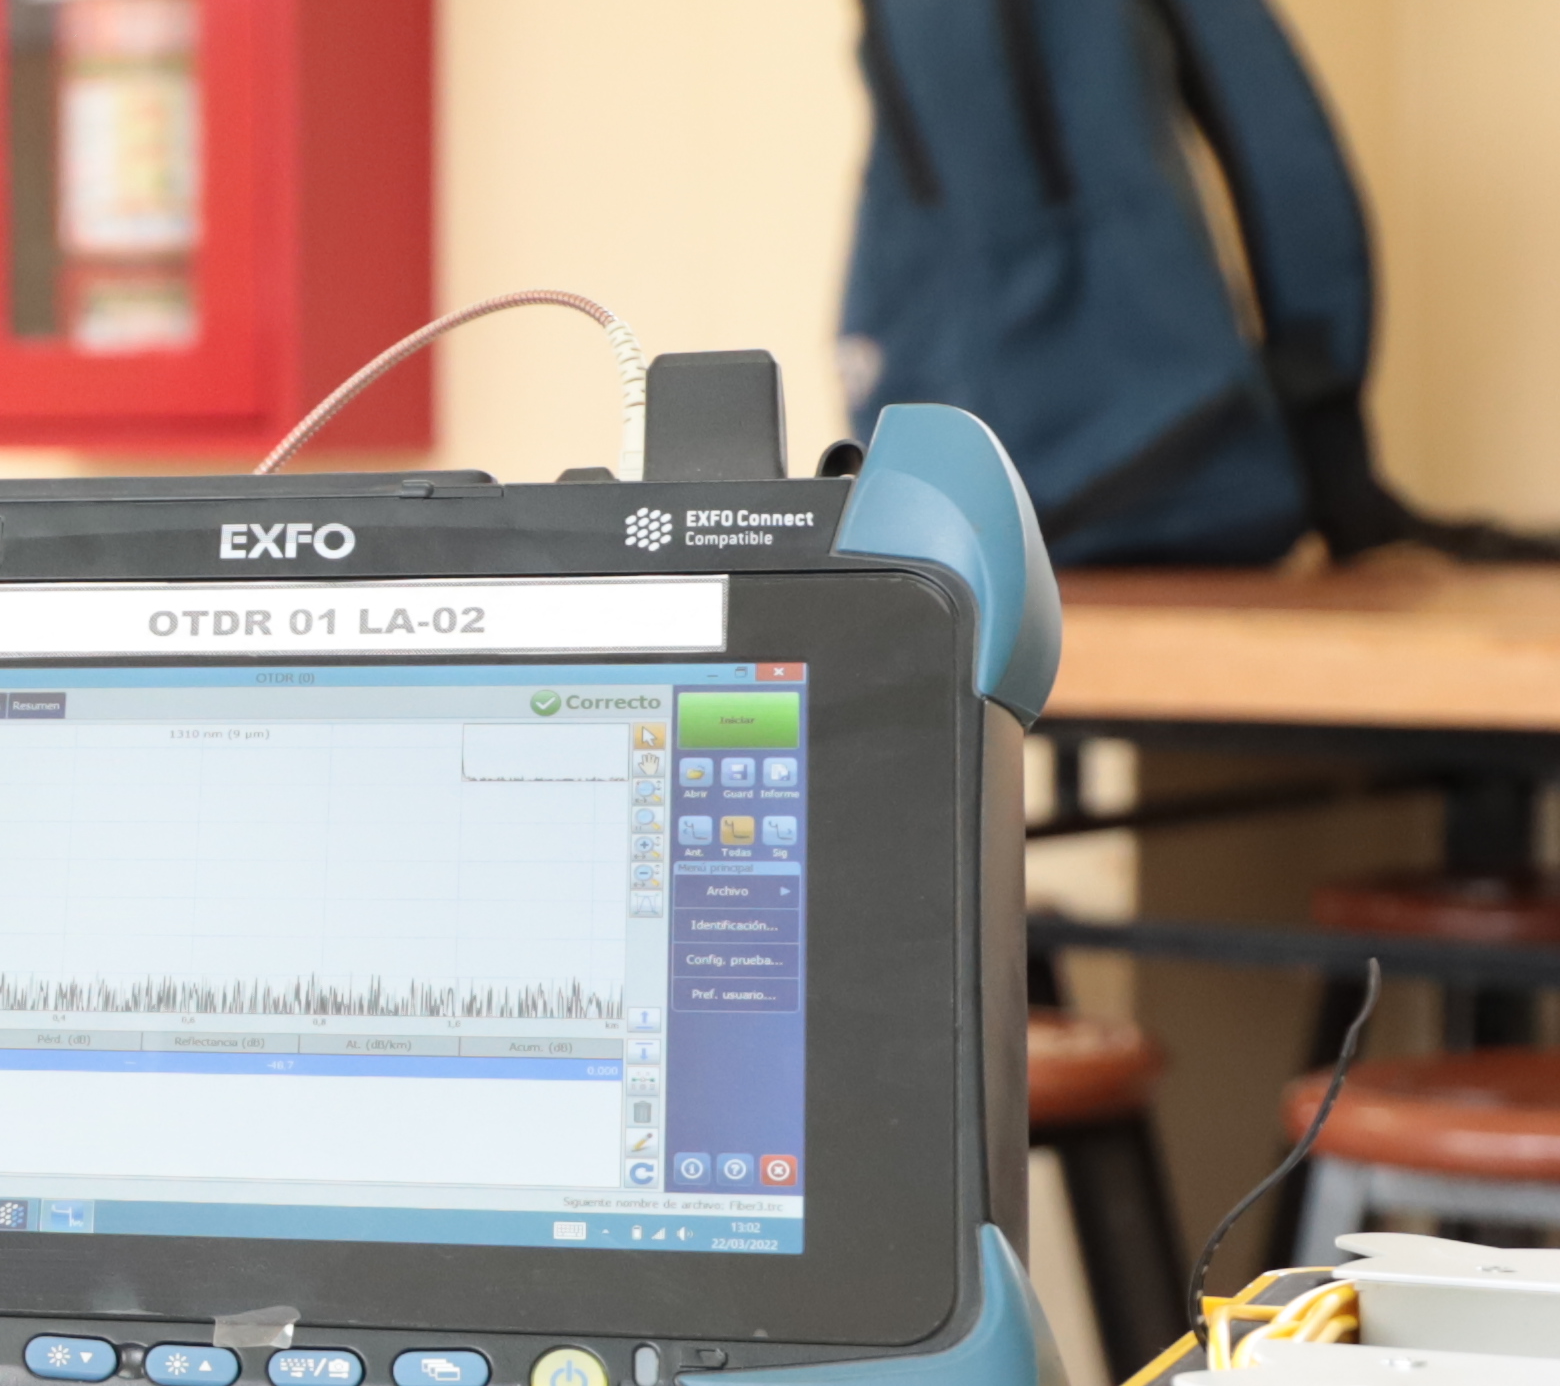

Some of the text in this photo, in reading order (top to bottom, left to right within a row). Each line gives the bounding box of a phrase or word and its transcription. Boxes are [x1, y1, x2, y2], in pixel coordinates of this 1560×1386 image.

[685, 510, 814, 527] EXFO Connect
[220, 522, 356, 559] EXFO
[685, 529, 773, 548] Compatible
[147, 606, 486, 637] OTDR 01 LA-02
[255, 671, 315, 685] OTDR (0)
[12, 700, 60, 711] Resumen
[565, 694, 661, 710] Correcto
[719, 715, 756, 725] Iniciar
[169, 729, 200, 739] 1310
[684, 789, 708, 799] Abrir
[723, 789, 754, 799] Guard
[760, 789, 800, 799] Informe
[721, 848, 752, 857] Todas
[710, 864, 754, 875] principal
[706, 885, 749, 897] Archivo
[686, 953, 726, 967] Config.
[691, 988, 718, 1000] Pref.
[174, 1037, 238, 1047] Reflectancia
[563, 1196, 612, 1209] Siguiente
[615, 1198, 662, 1209] nombre
[663, 1199, 677, 1209] de
[730, 1221, 761, 1233] 13:02
[711, 1238, 779, 1251] 22/03/2022
